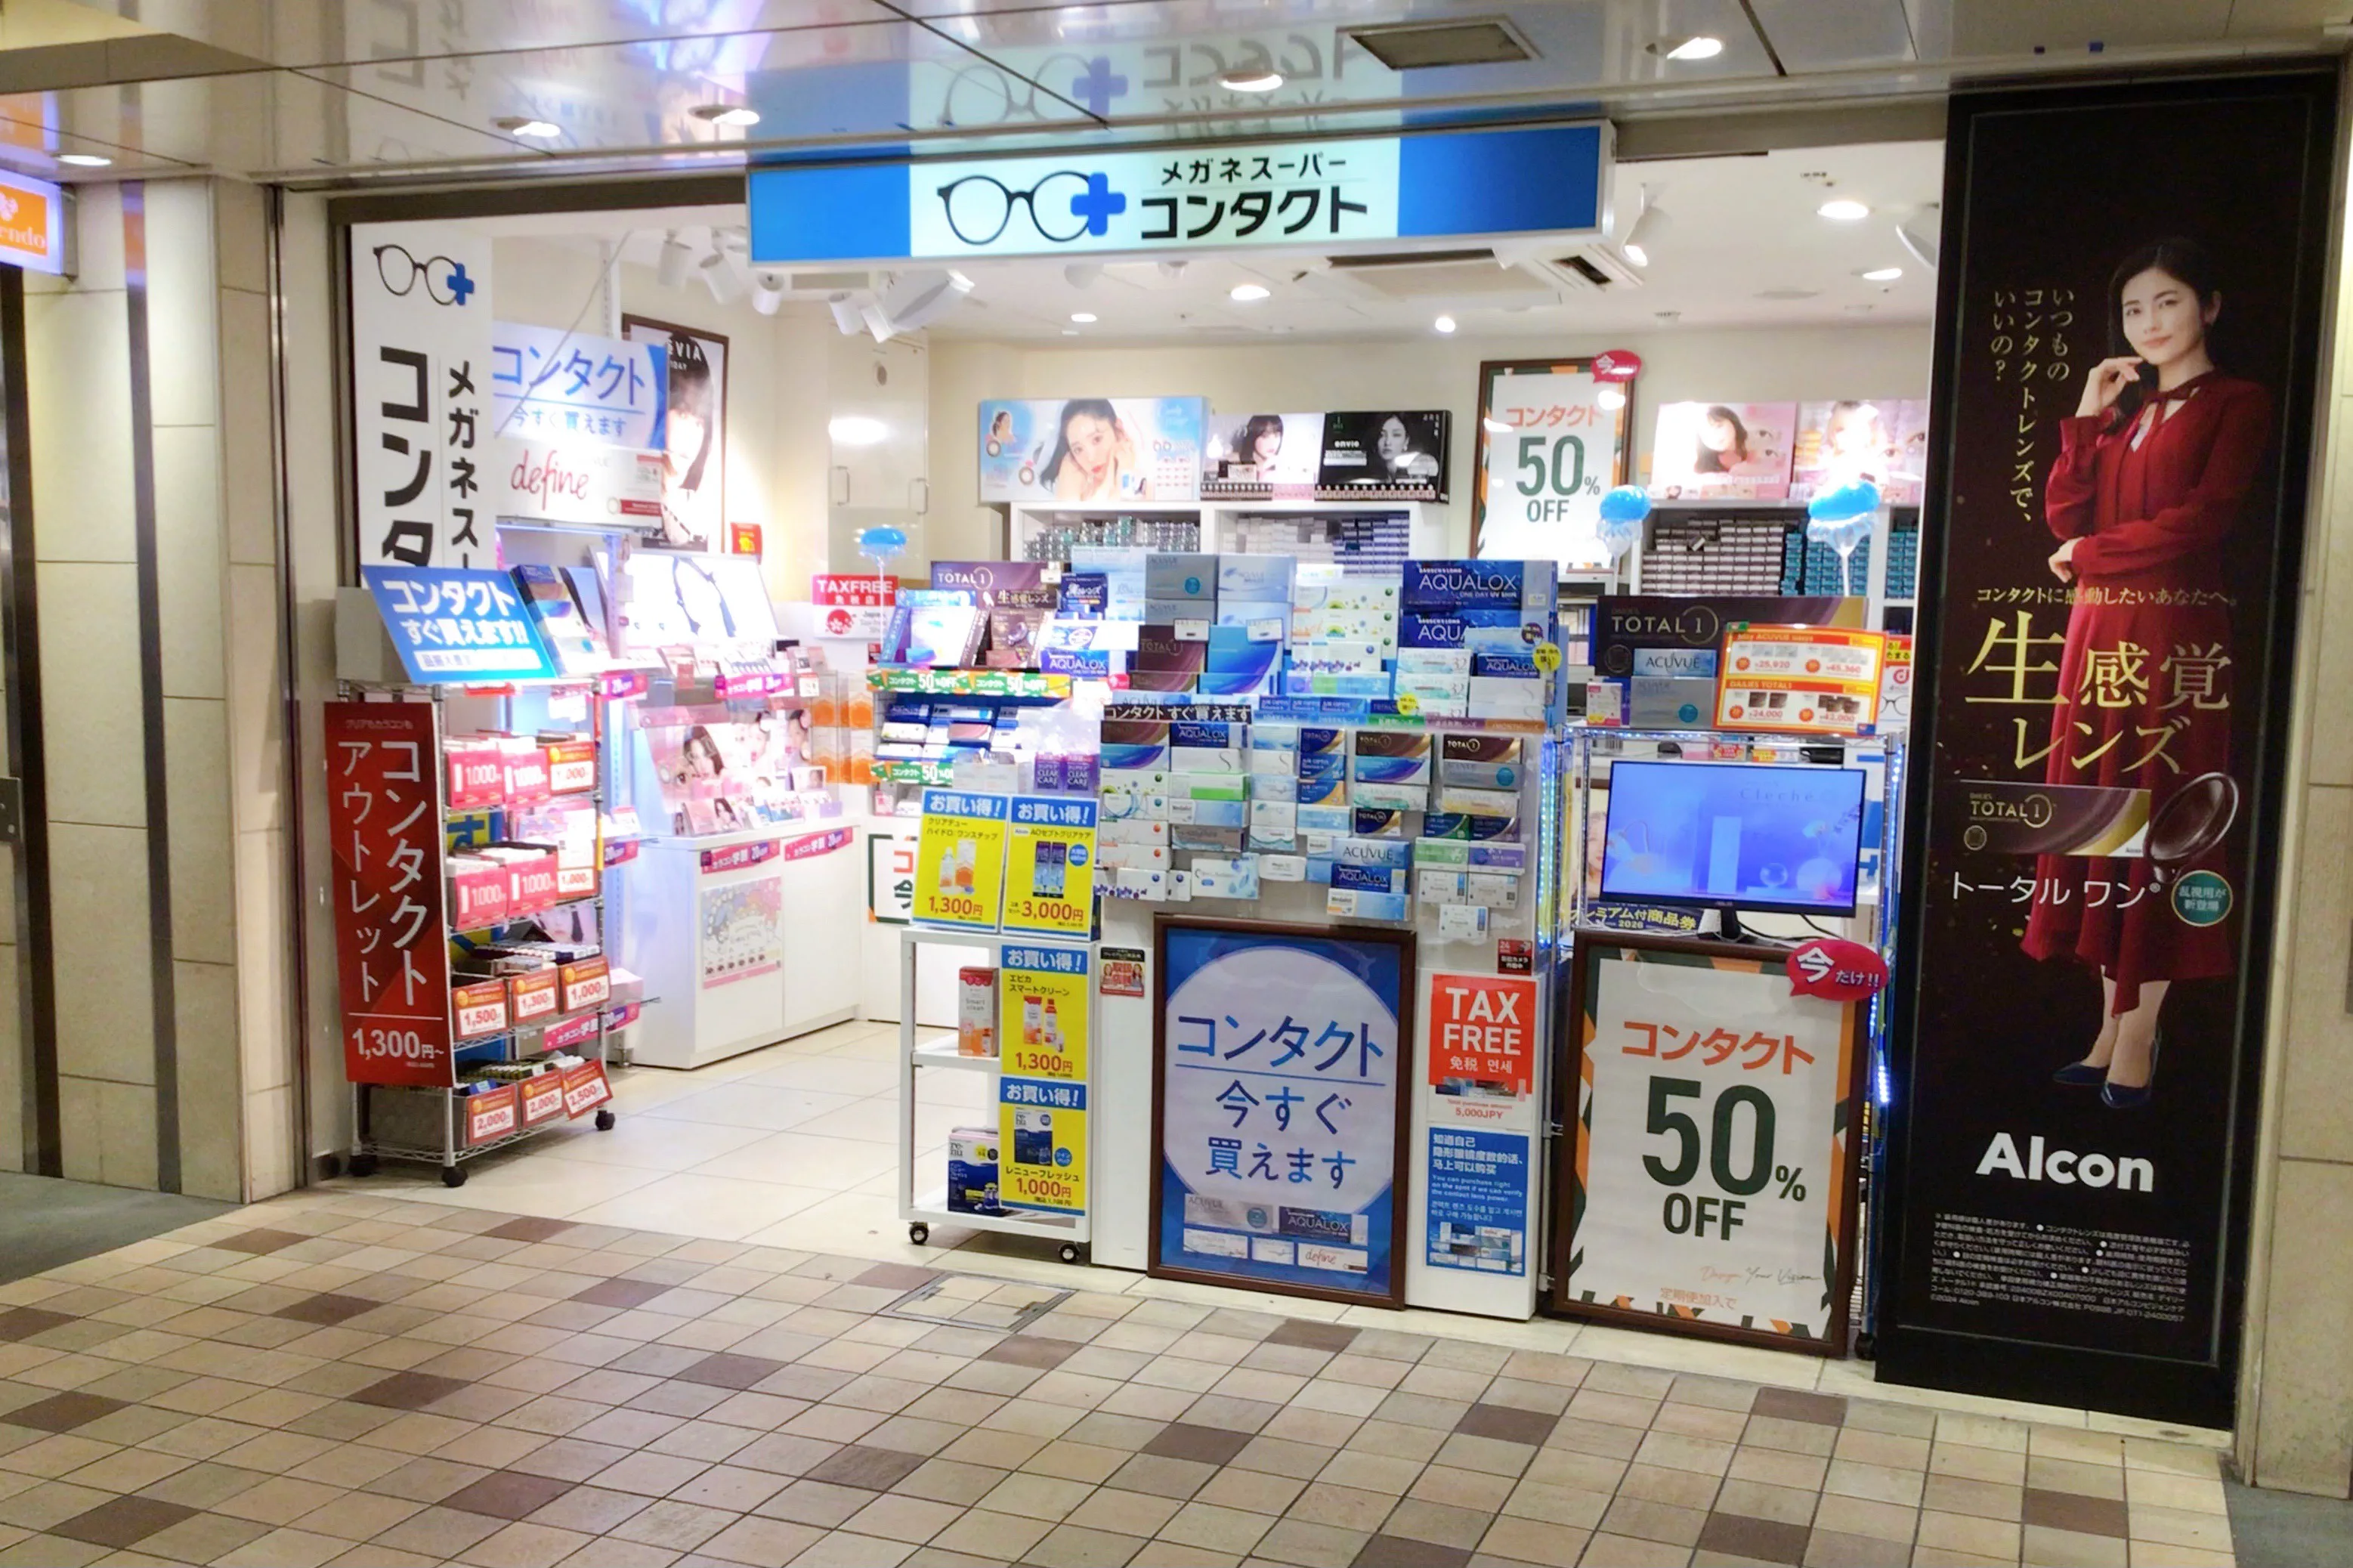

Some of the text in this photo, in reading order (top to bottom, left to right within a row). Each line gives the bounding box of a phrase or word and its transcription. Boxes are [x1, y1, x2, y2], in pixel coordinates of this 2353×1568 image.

[1161, 152, 1346, 186] メガネスーパー
[1142, 185, 1368, 240] コンタクト
[2047, 290, 2074, 380] いつもの
[493, 346, 645, 405] コンタクト
[1506, 405, 1603, 428] コンタクト
[2010, 289, 2044, 523] コンタクトレンズで、
[511, 449, 589, 511] define
[1526, 499, 1569, 522] OFF
[938, 573, 976, 584] TOTAL
[1419, 574, 1517, 591] AQUALOX
[382, 580, 516, 616] コンタクト
[1612, 616, 1686, 633] TOTAL
[1050, 659, 1107, 670] AQUALOX
[1645, 656, 1700, 670] ACUVUE
[1965, 610, 2232, 710] 生感覚
[1105, 705, 1251, 722] コンタクト すぐ買えます
[1179, 728, 1226, 739] AQUALOX
[2012, 716, 2191, 775] レンズ
[930, 793, 1001, 818] お買い得!
[1018, 803, 1090, 822] お買い得!
[1970, 800, 2028, 818] TOTAL
[1343, 844, 1393, 860] ACUVUE
[338, 741, 380, 1004] アウトレット
[381, 741, 428, 1006] コンタクト
[1338, 871, 1388, 884] AQUALOX
[1953, 871, 2070, 906] トータル
[929, 895, 983, 916] 1,300円
[1022, 900, 1084, 922] 3,000円
[1007, 949, 1081, 973] お買い得!
[1009, 985, 1070, 997] スマートクリーン
[1446, 986, 1520, 1025] TAX
[1177, 1015, 1384, 1078] コンタクト
[1443, 1023, 1521, 1056] FREE
[1622, 1021, 1815, 1075] コンタクト
[1015, 1052, 1073, 1072] 1,300円
[1006, 1084, 1079, 1106] お買い得!
[1215, 1079, 1353, 1135] 今すぐ
[1642, 1075, 1806, 1203] 50%
[1006, 1166, 1079, 1182] レニューフレッシュ
[1205, 1137, 1356, 1189] 買えます
[1975, 1132, 2154, 1192] Alcon
[1016, 1177, 1071, 1198] 1,000円
[1288, 1216, 1351, 1232] AQUALOX
[1662, 1192, 1746, 1241] OFF
[1305, 1248, 1337, 1266] define
